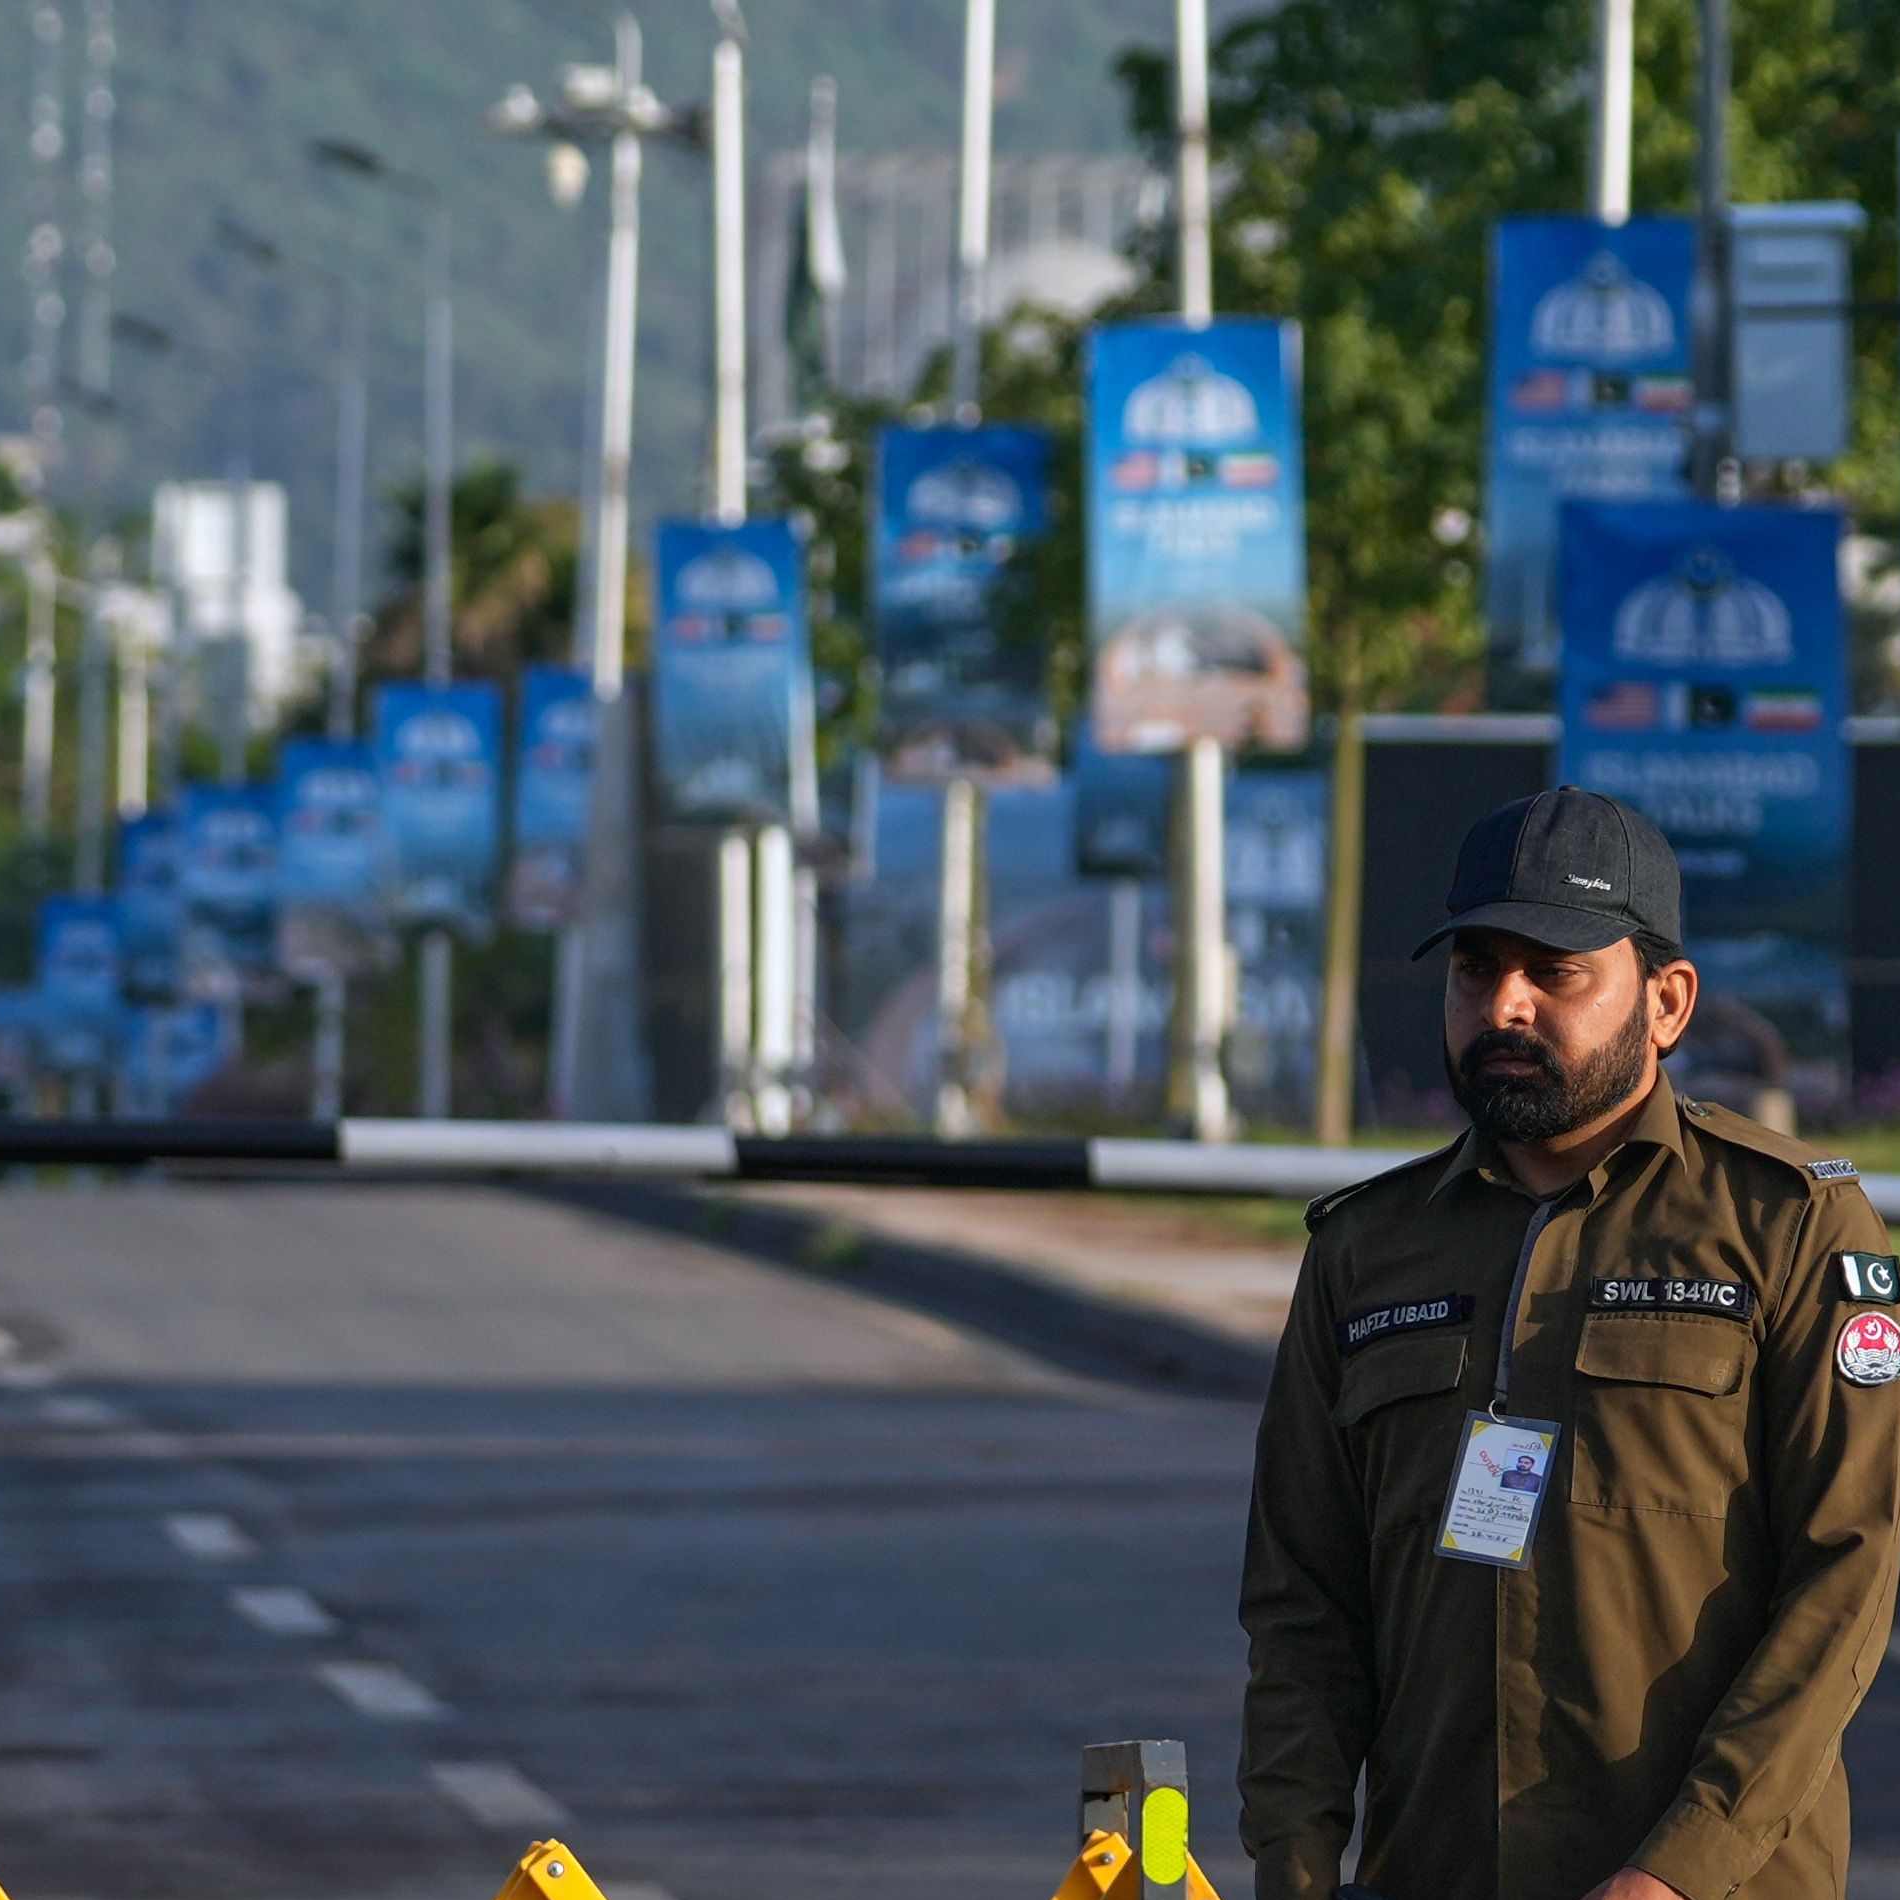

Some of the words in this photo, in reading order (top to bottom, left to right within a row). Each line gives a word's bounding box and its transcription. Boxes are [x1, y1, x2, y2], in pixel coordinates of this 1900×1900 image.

[1604, 1281, 1655, 1301] SWL
[1663, 1281, 1736, 1306] 1341/C
[1348, 1310, 1390, 1342] HAFIZ
[1393, 1301, 1449, 1325] UBAID
